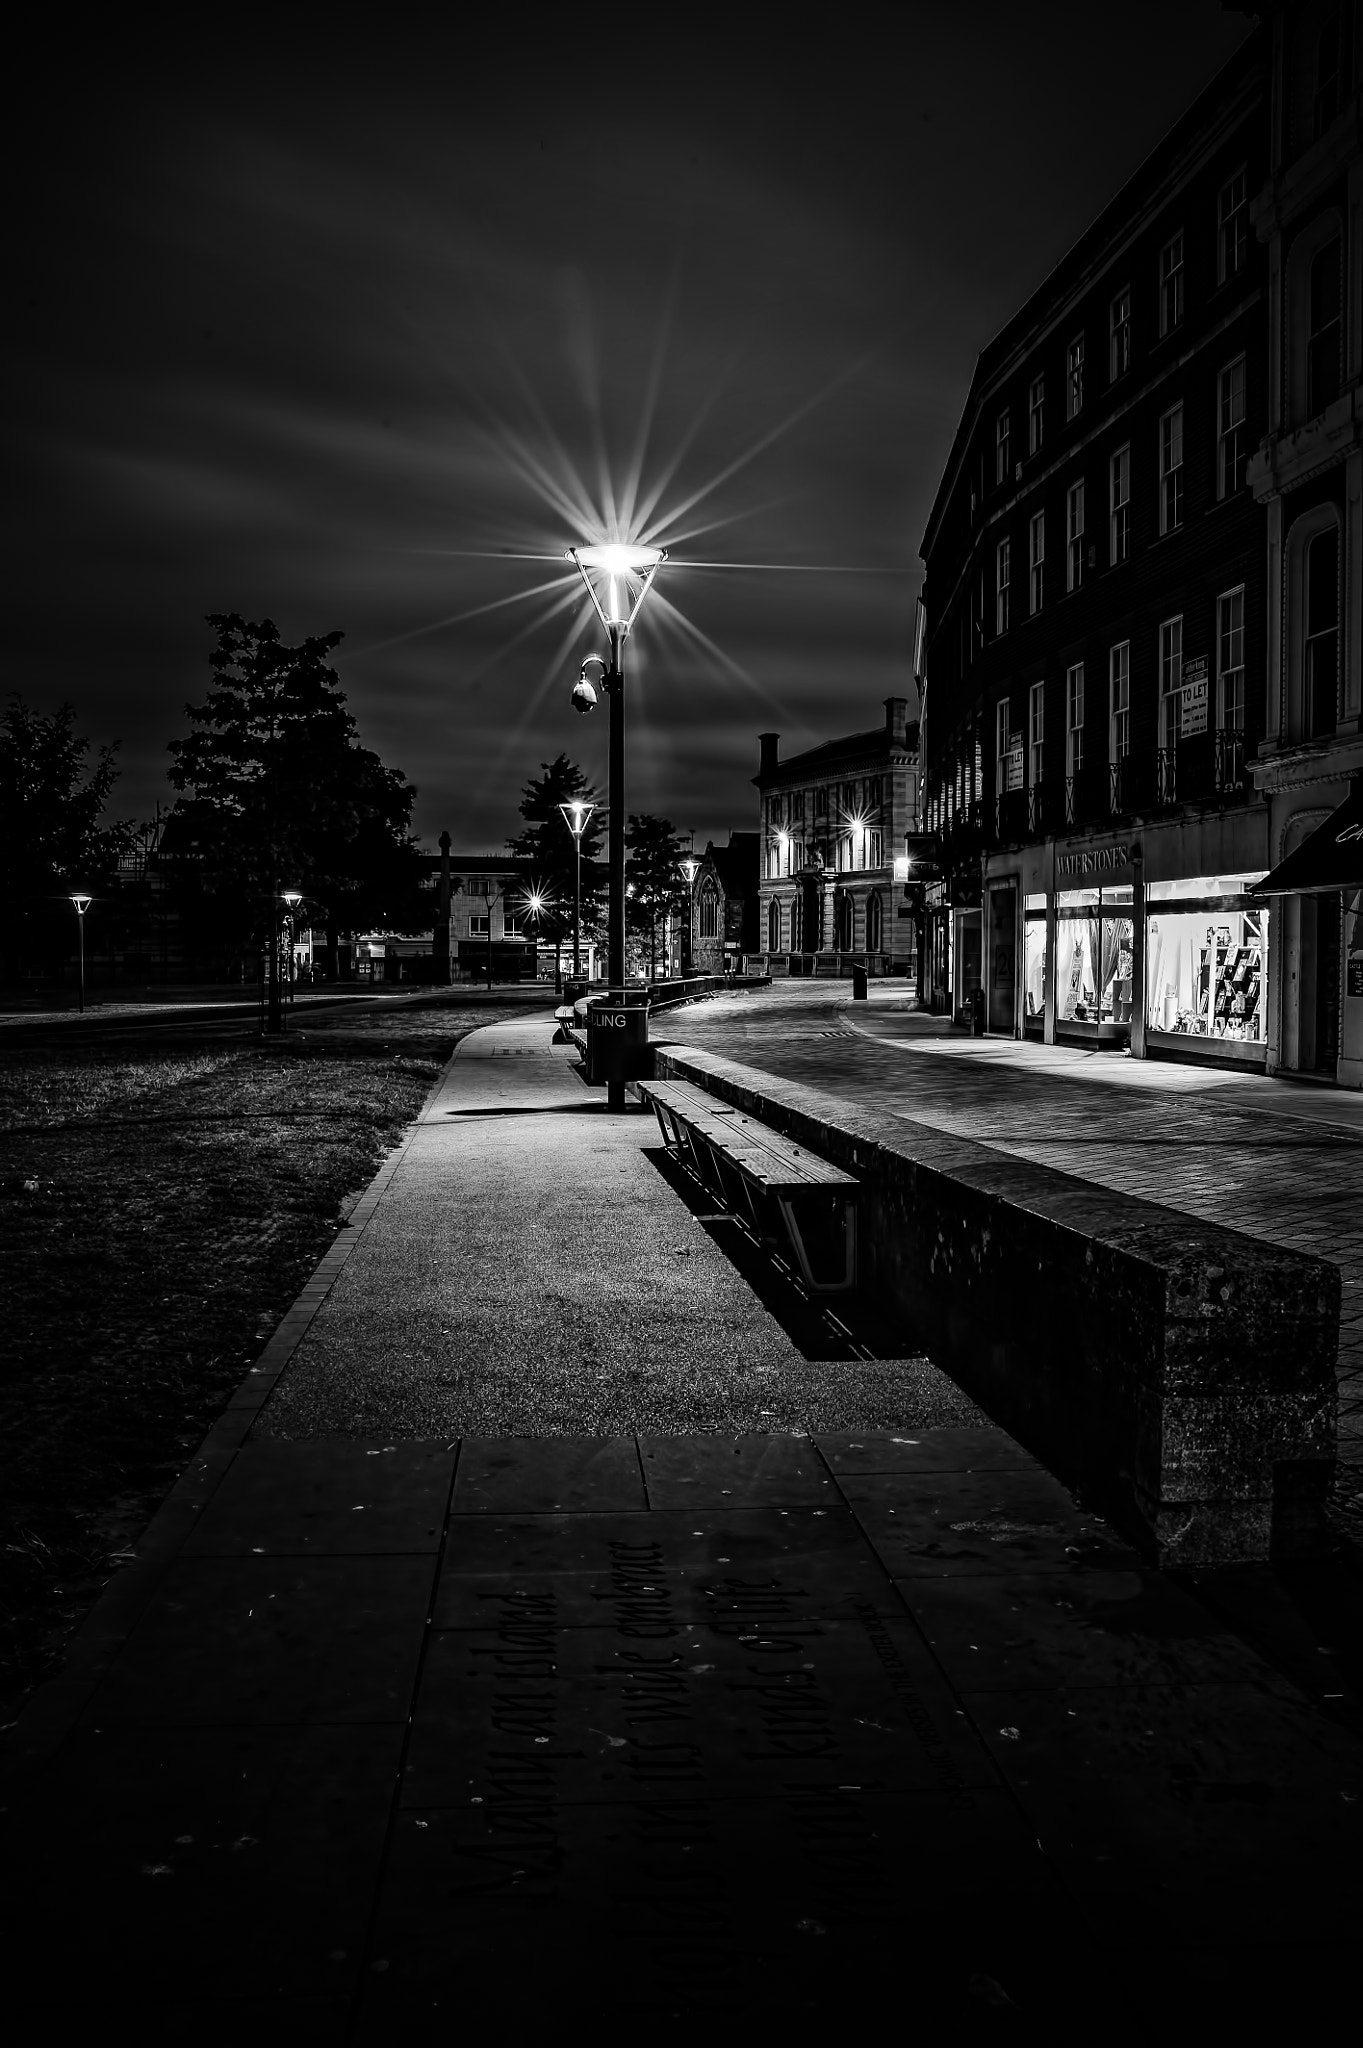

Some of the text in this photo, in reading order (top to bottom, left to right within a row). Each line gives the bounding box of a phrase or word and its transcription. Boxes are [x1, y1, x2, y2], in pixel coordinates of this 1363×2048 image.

[1183, 683, 1207, 703] TO LET
[1057, 845, 1127, 875] WATERSTONE'S
[869, 1631, 905, 1669] EXETER
[449, 1592, 587, 1904] Many an island
[904, 1706, 944, 1748] VERSES
[698, 1578, 908, 1926] many kinds of life
[591, 1540, 752, 2015] holds in its wide embrace
